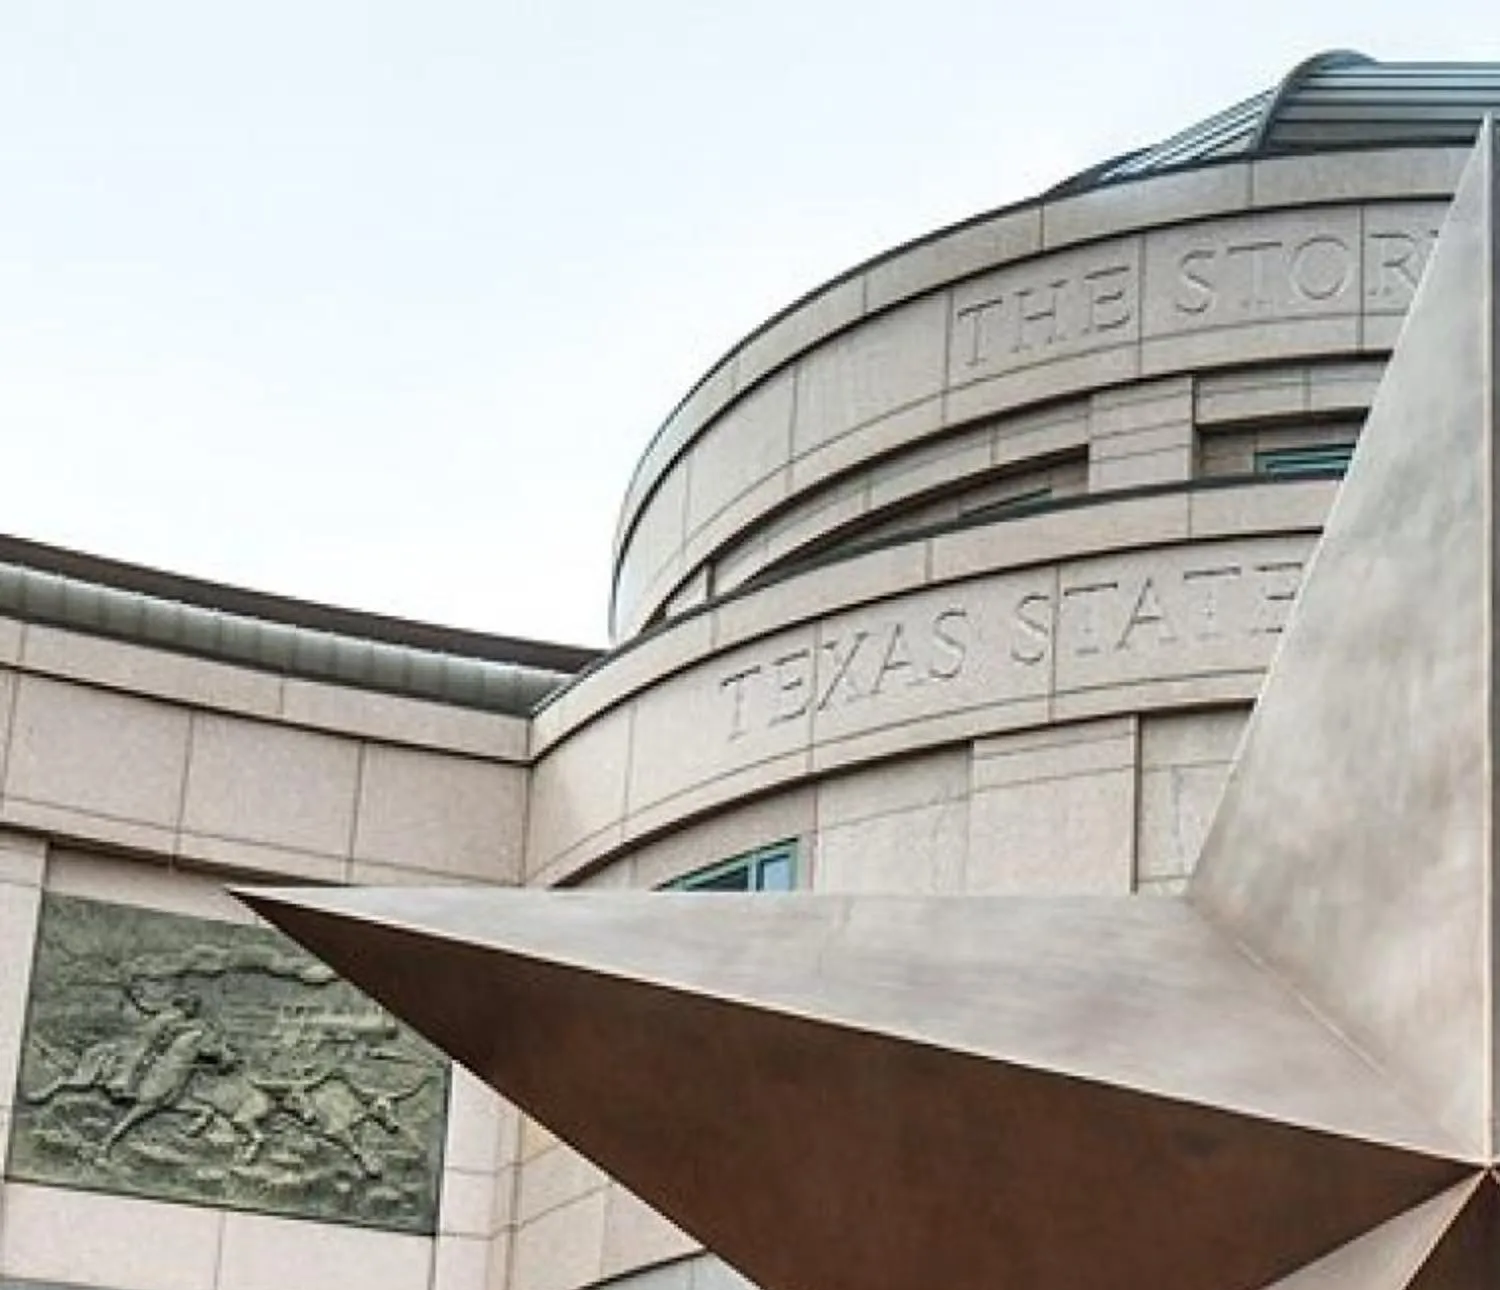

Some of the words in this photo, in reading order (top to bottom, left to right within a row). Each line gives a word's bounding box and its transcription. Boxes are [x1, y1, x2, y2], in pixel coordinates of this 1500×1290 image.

[956, 264, 1132, 366] THE
[720, 609, 968, 741] TEXAS
[1010, 562, 1305, 667] STATE
